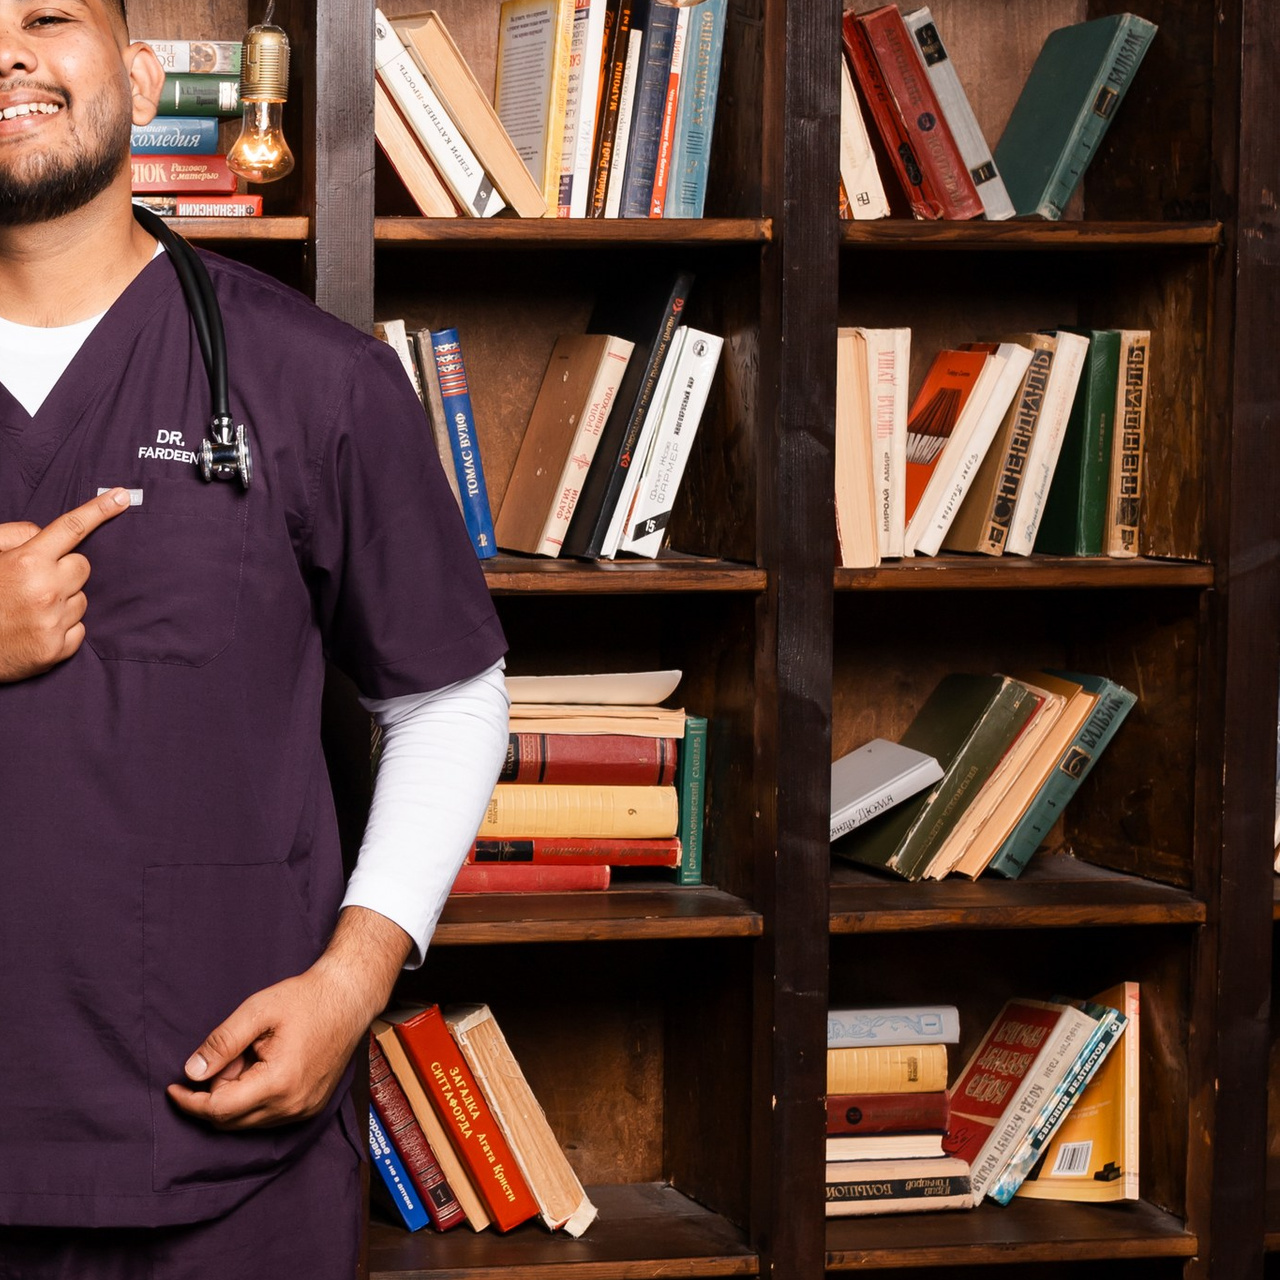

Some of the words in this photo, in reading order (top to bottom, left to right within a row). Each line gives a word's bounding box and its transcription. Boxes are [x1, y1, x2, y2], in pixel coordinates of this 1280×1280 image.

[1104, 27, 1147, 87] БАЛЬЗАК
[607, 60, 623, 112] МАРОНЫ
[129, 122, 203, 153] комедия
[420, 100, 452, 145] КАТТНЕР
[170, 162, 207, 174] Разговор
[177, 170, 219, 182] матерью
[448, 144, 474, 178] ГЕНРИ
[623, 406, 645, 452] Народные
[661, 314, 676, 342] цыган
[877, 350, 898, 387] ДУША
[453, 410, 470, 448] ВУЛФ
[582, 401, 603, 433] ТРОПА
[587, 384, 618, 435] ПЕШЕХОДА
[877, 394, 895, 439] ЧИСТАЯ
[138, 446, 199, 465] FARDEEN
[156, 429, 185, 447] DR.
[991, 347, 1056, 525] СТЕНДАЛЬ
[460, 449, 479, 497] ТОМАС
[653, 441, 683, 504] ФАРМЕР
[883, 451, 891, 481] АМИР
[552, 485, 575, 519] ФАТИХ
[560, 488, 582, 521] ХУСНИ
[644, 519, 656, 533] 15
[1076, 691, 1125, 750] БАЛЬЗАК
[692, 736, 702, 777] СЛОВАРЬ
[686, 781, 700, 868] ОРФОГРАФИЧЕСКИЙ
[424, 1059, 479, 1140] СИТТАФОРДА
[444, 1064, 484, 1120] ЗАГАДКА
[1034, 1093, 1072, 1141] ЕВГЕНИЙ
[1066, 1039, 1108, 1095] ВЕЛТИСТОВ
[475, 1130, 499, 1163] Агата
[490, 1162, 520, 1204] Кристи
[902, 1175, 949, 1190] Гончаров
[823, 1179, 893, 1202] БОЛЬШОЙ
